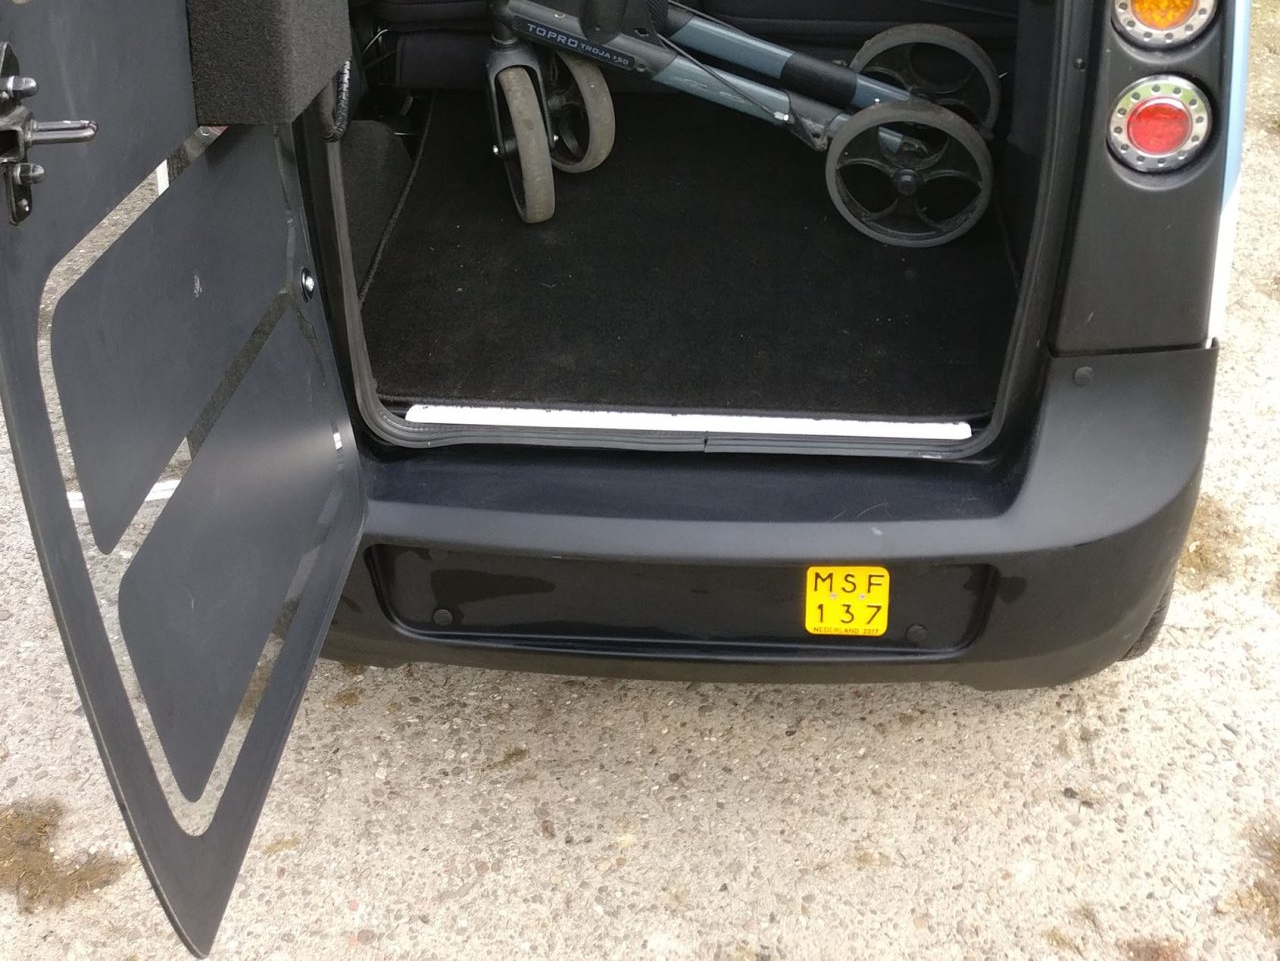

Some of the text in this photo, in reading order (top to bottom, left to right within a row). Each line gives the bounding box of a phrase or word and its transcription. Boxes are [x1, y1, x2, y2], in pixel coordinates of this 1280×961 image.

[527, 23, 578, 48] TOPRO
[580, 43, 611, 60] TROJA
[814, 572, 885, 594] MSF
[817, 604, 882, 625] 137
